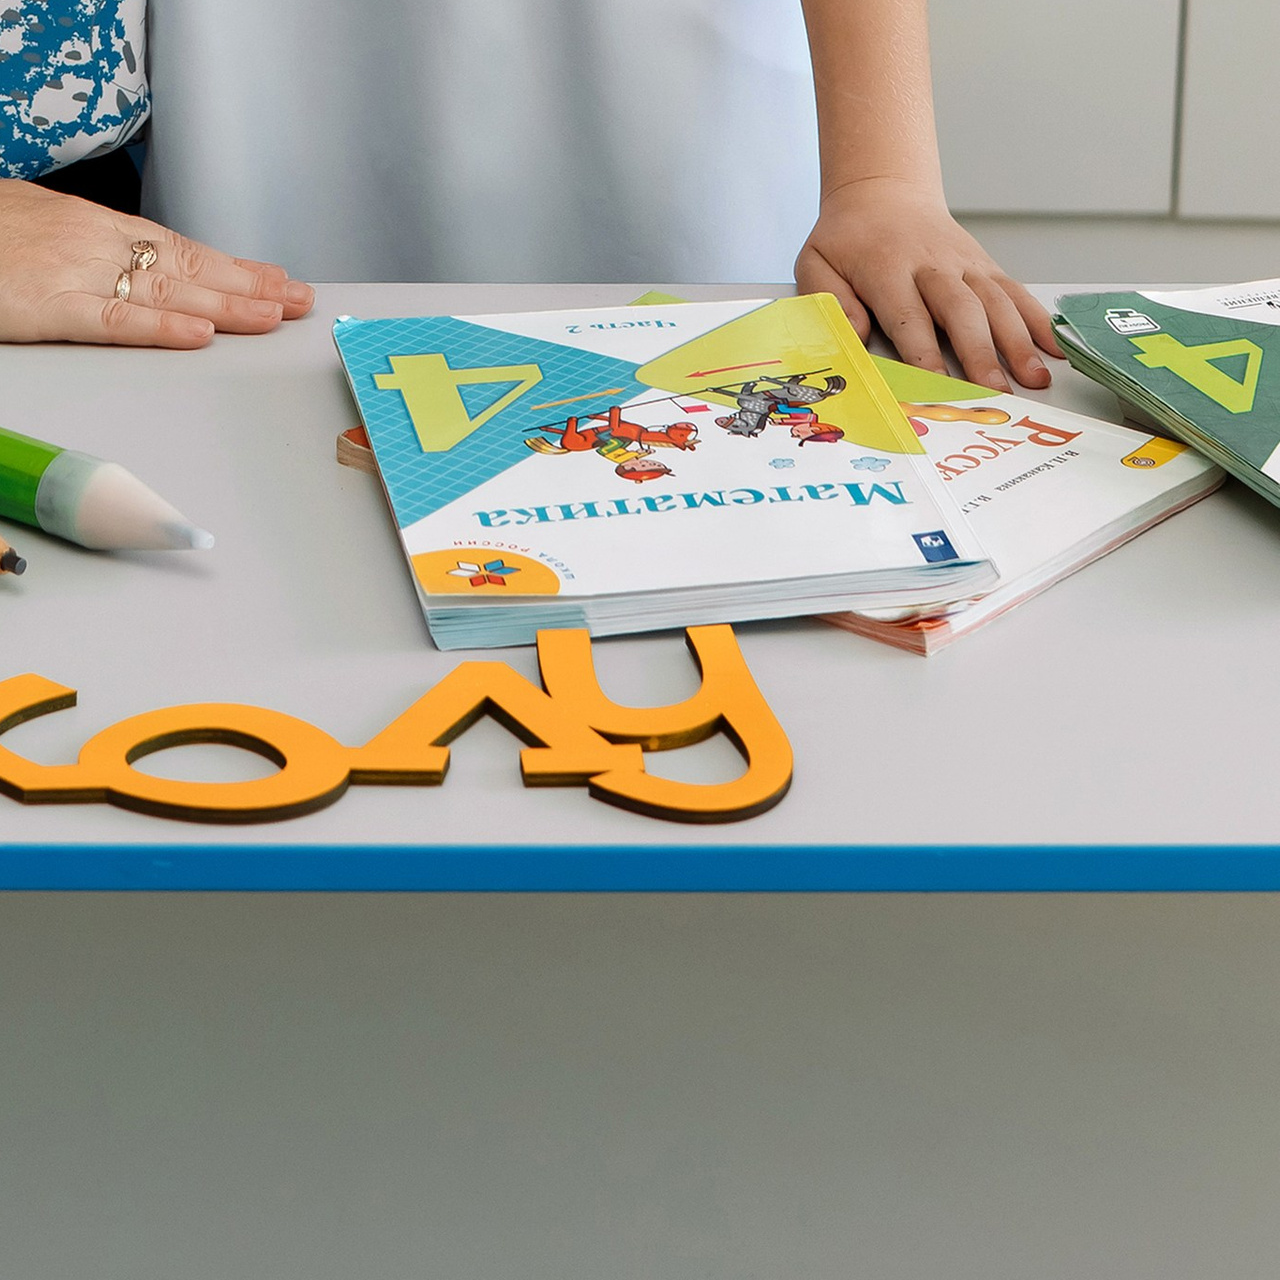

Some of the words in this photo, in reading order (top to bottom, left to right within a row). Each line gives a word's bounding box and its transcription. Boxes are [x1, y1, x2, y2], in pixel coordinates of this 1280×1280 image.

[565, 324, 583, 336] 2
[589, 318, 677, 334] Часть
[1127, 332, 1264, 415] 4
[372, 351, 544, 453] 4
[471, 479, 916, 530] Математика
[451, 539, 530, 554] РОССИИ
